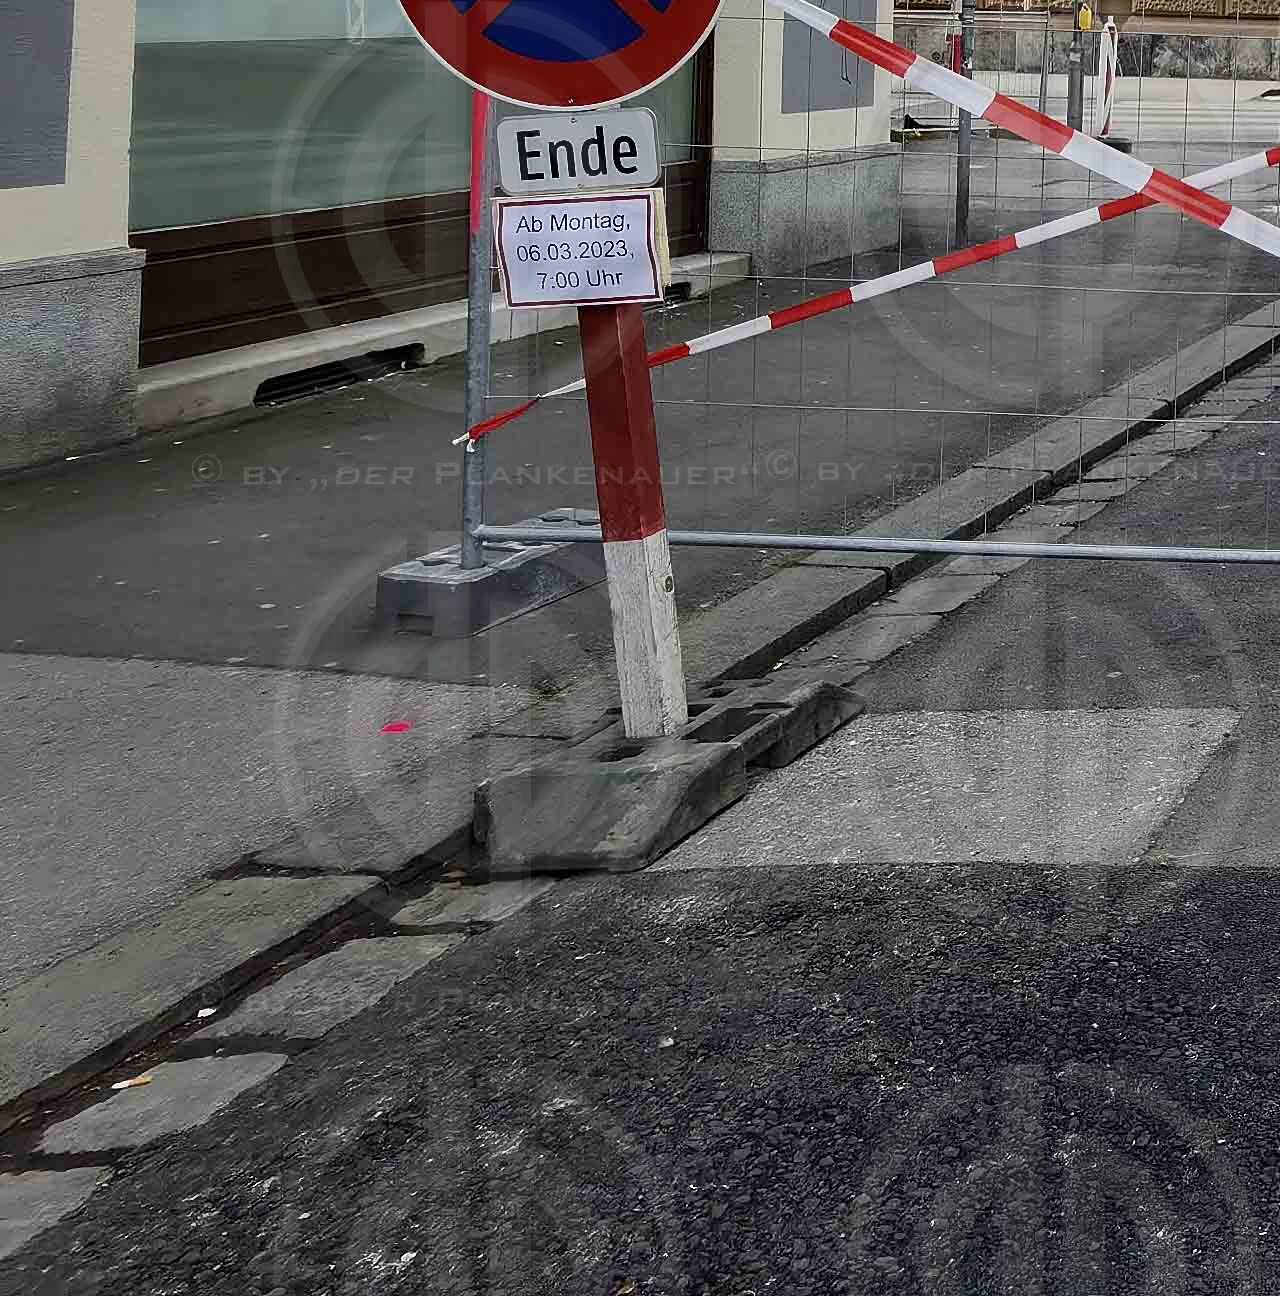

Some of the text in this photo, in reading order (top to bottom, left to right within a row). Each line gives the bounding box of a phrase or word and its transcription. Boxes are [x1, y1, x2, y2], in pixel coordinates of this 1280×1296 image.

[516, 125, 638, 181] Ende
[516, 212, 630, 233] Ab Montag,
[516, 239, 635, 262] 06.03.2023,
[536, 269, 623, 289] 7:00 Uhr
